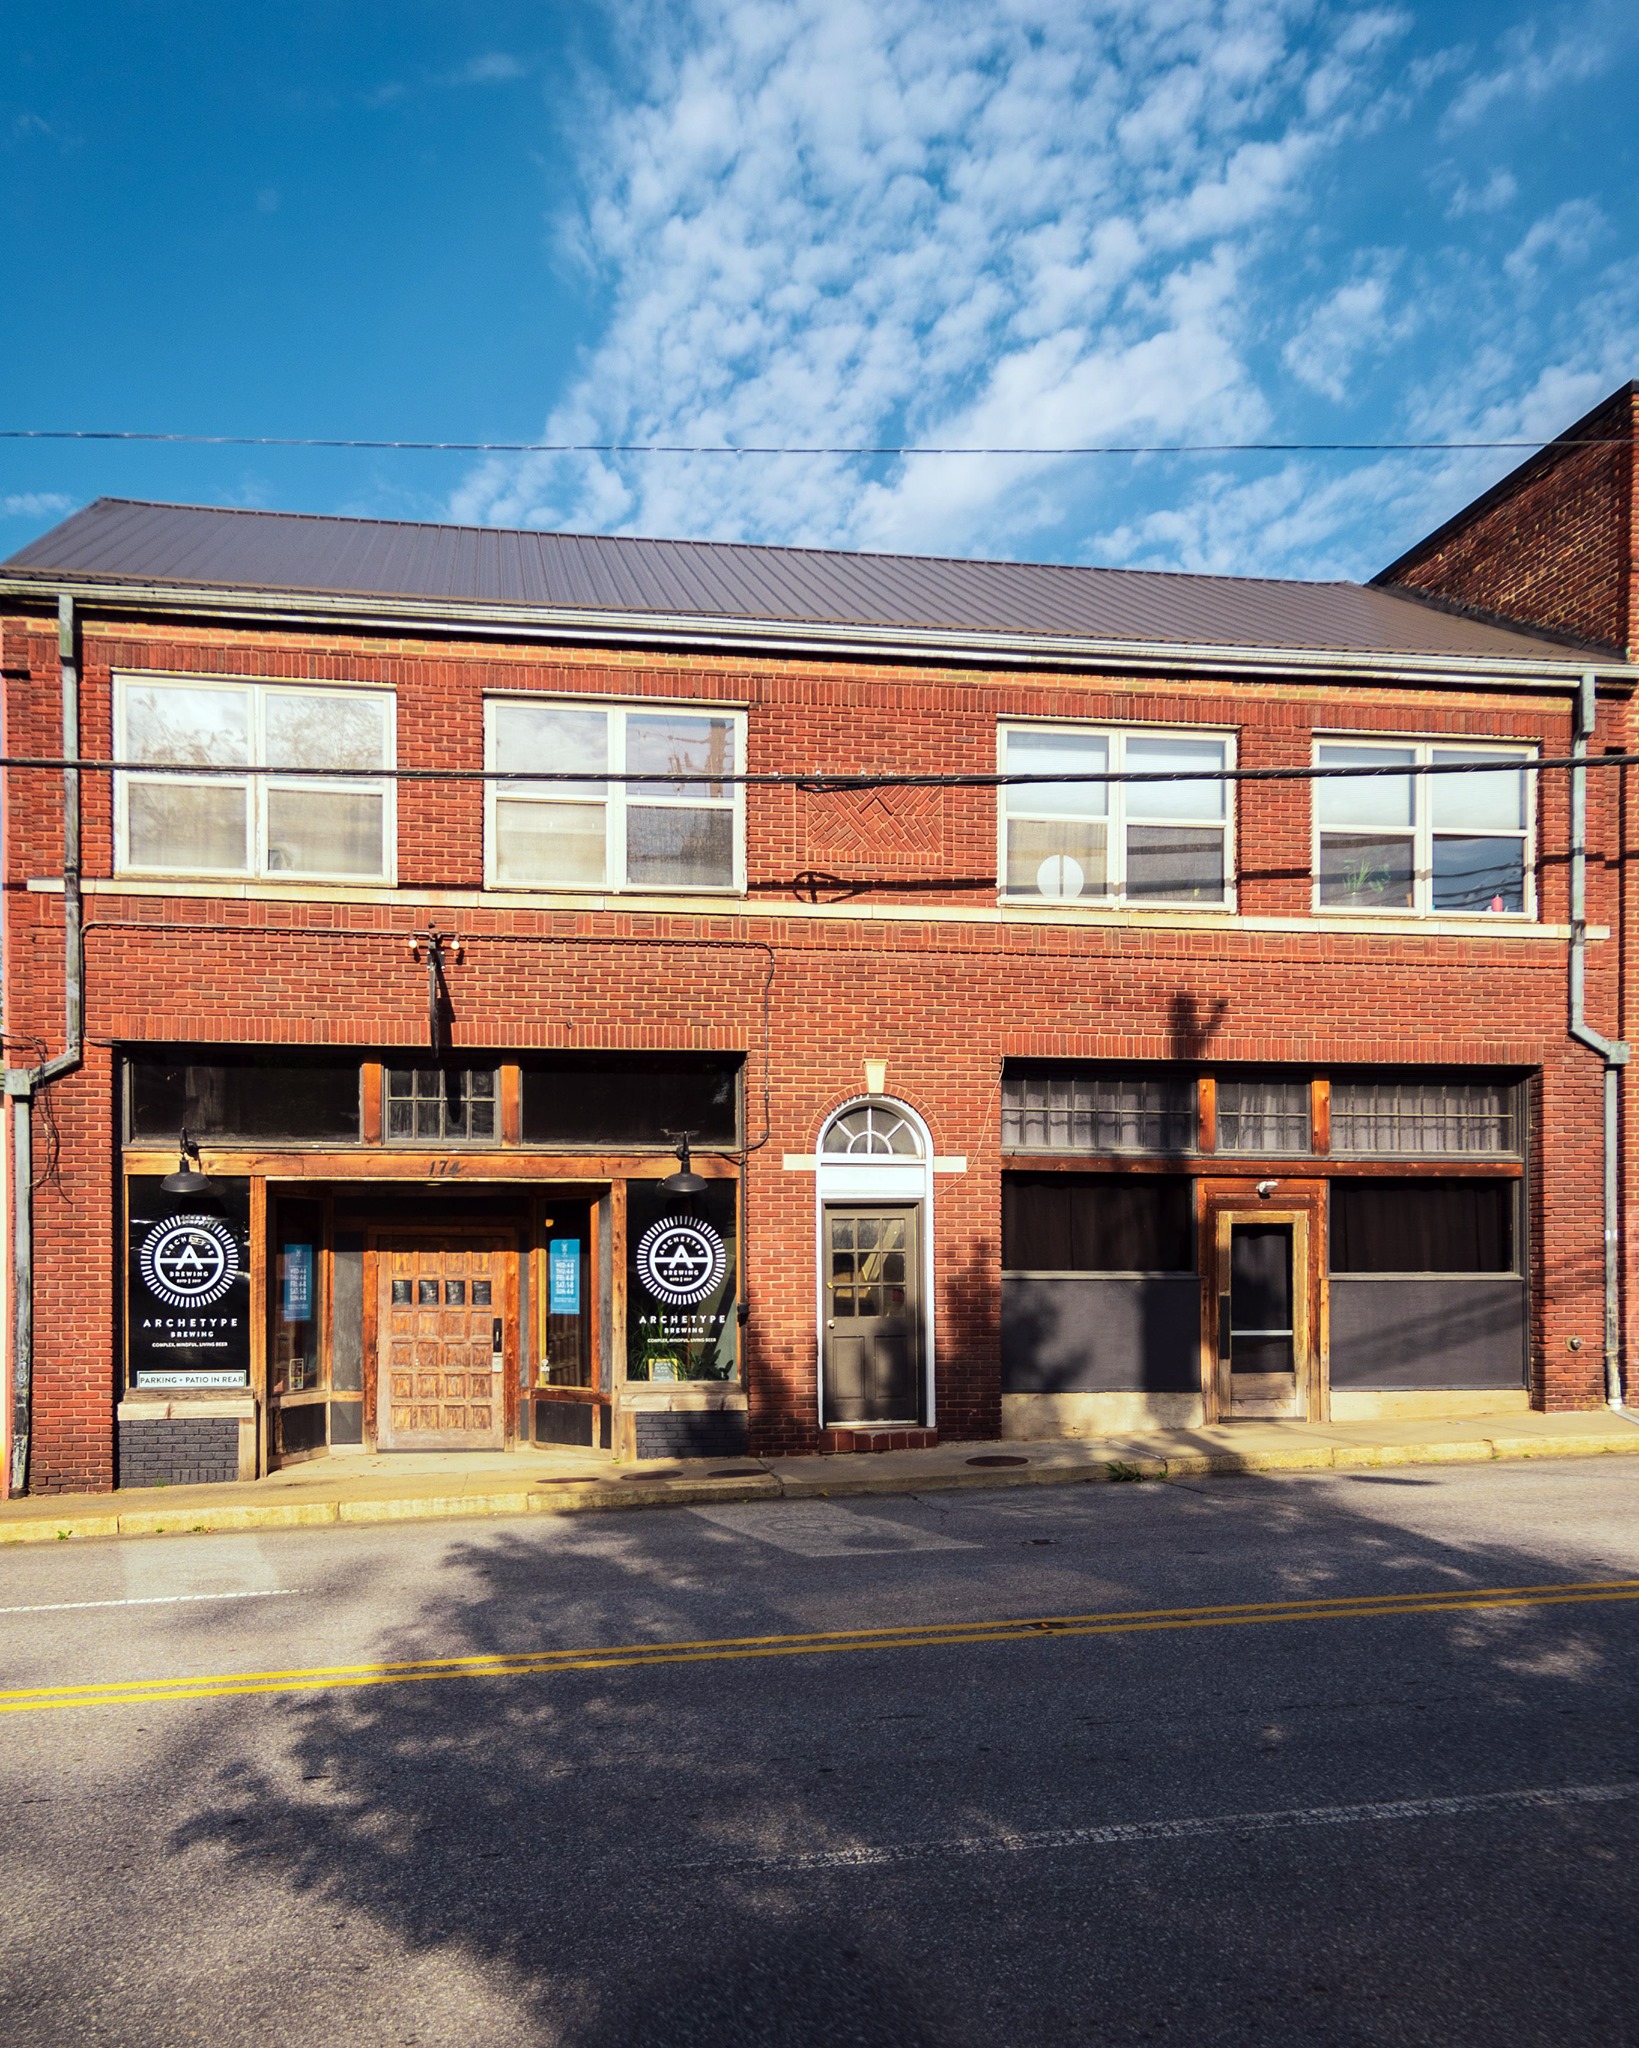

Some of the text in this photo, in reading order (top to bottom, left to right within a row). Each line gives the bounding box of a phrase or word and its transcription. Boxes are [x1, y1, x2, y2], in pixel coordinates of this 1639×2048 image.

[429, 1160, 460, 1175] 174
[659, 1236, 704, 1255] ARCHETYPE
[143, 1318, 238, 1328] ARCHETYPE
[639, 1315, 726, 1324] ARCHETYPE
